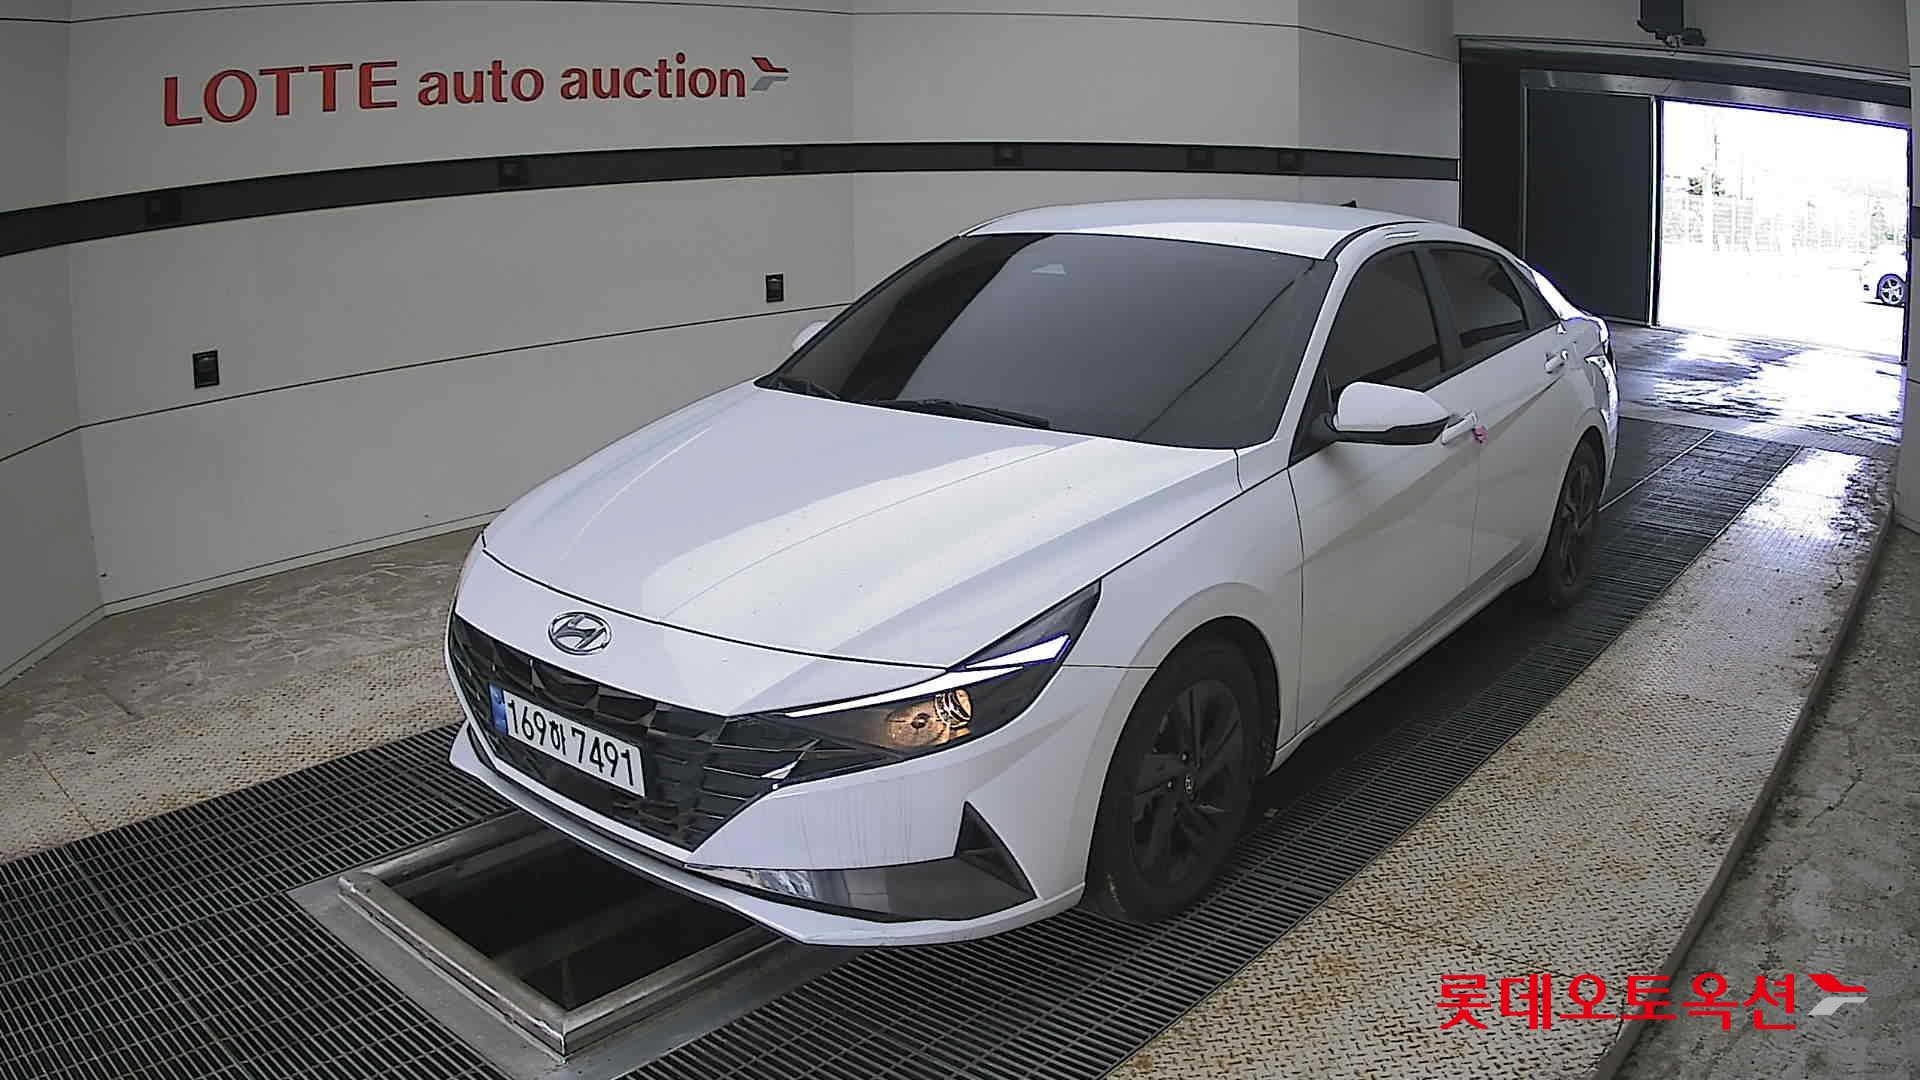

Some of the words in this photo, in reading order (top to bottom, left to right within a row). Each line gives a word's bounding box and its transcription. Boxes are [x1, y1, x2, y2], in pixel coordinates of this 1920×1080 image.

[164, 61, 398, 126] LOTTE
[418, 59, 544, 105] auto
[561, 52, 746, 99] auction
